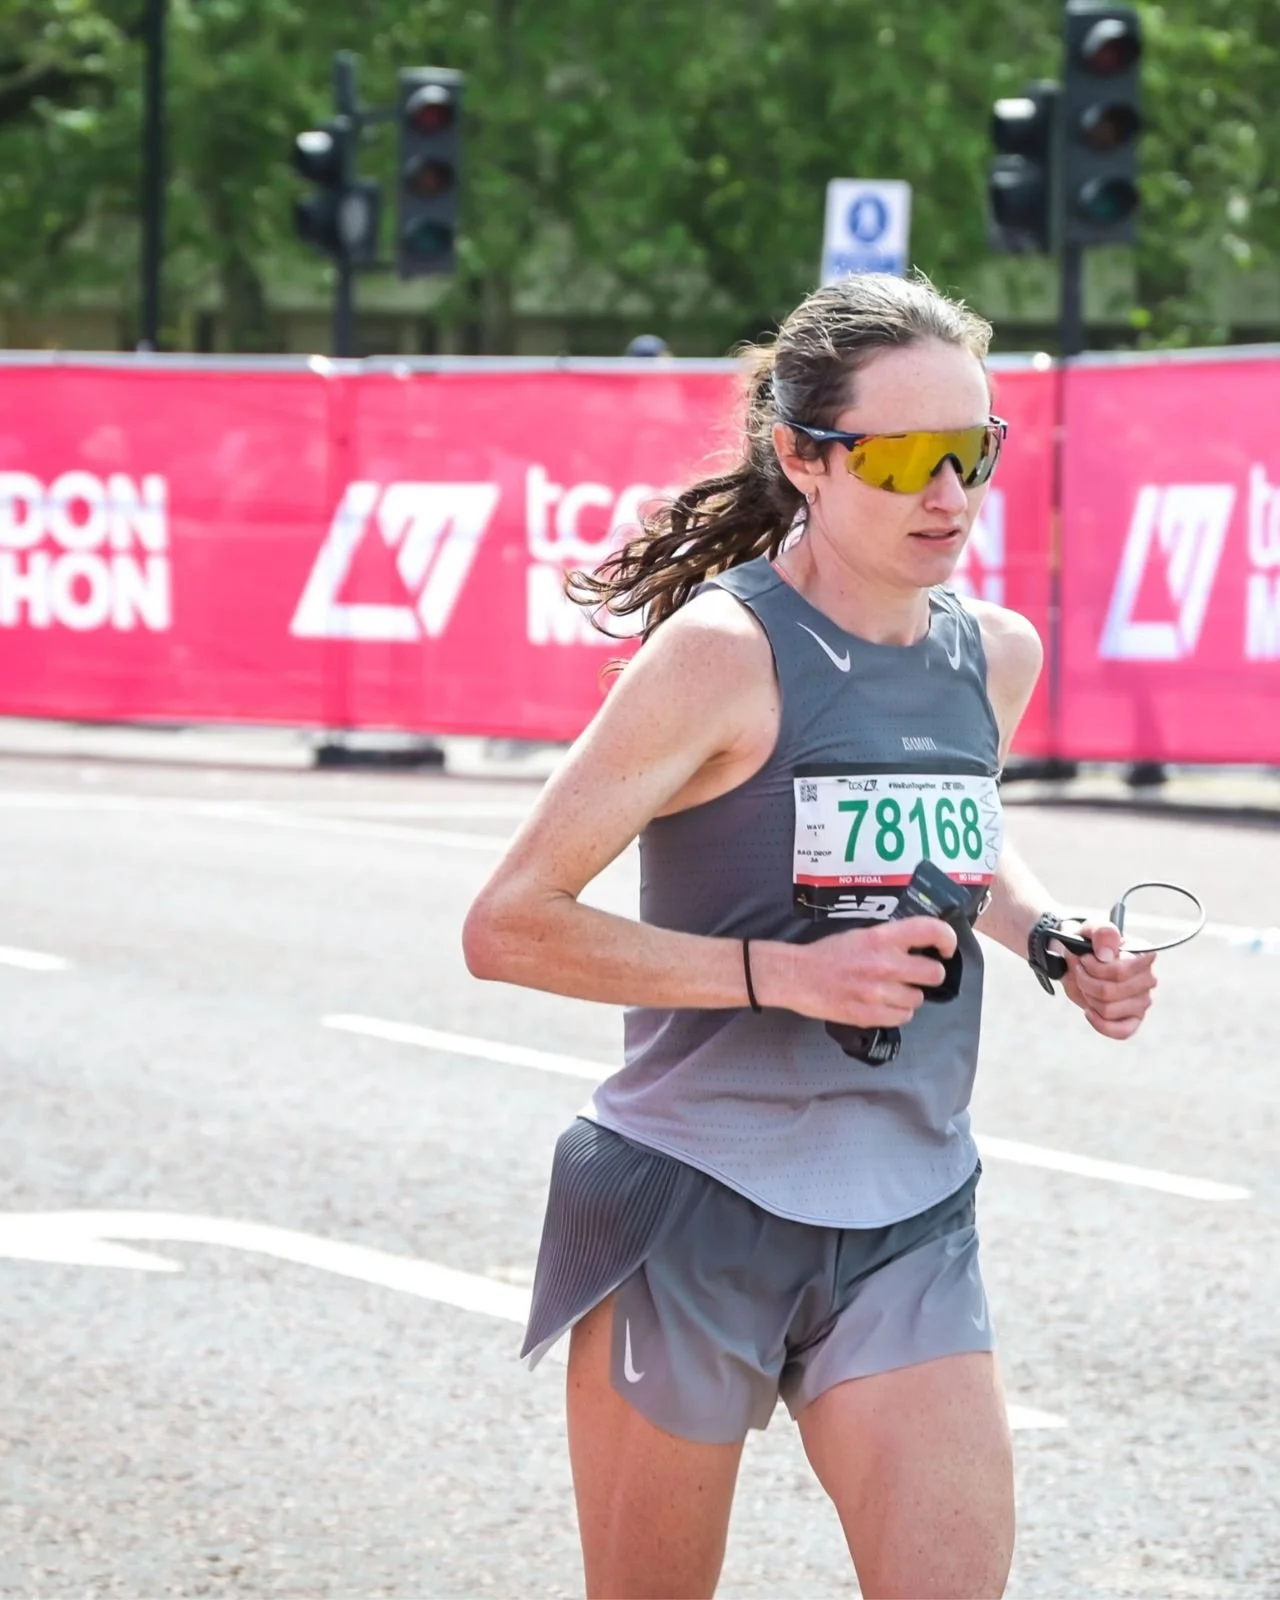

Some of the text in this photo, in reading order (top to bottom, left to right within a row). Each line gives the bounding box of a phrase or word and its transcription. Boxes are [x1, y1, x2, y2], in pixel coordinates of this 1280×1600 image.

[806, 823, 825, 831] WAVE
[838, 797, 982, 863] 78168
[839, 876, 883, 884] NO MEDAL
